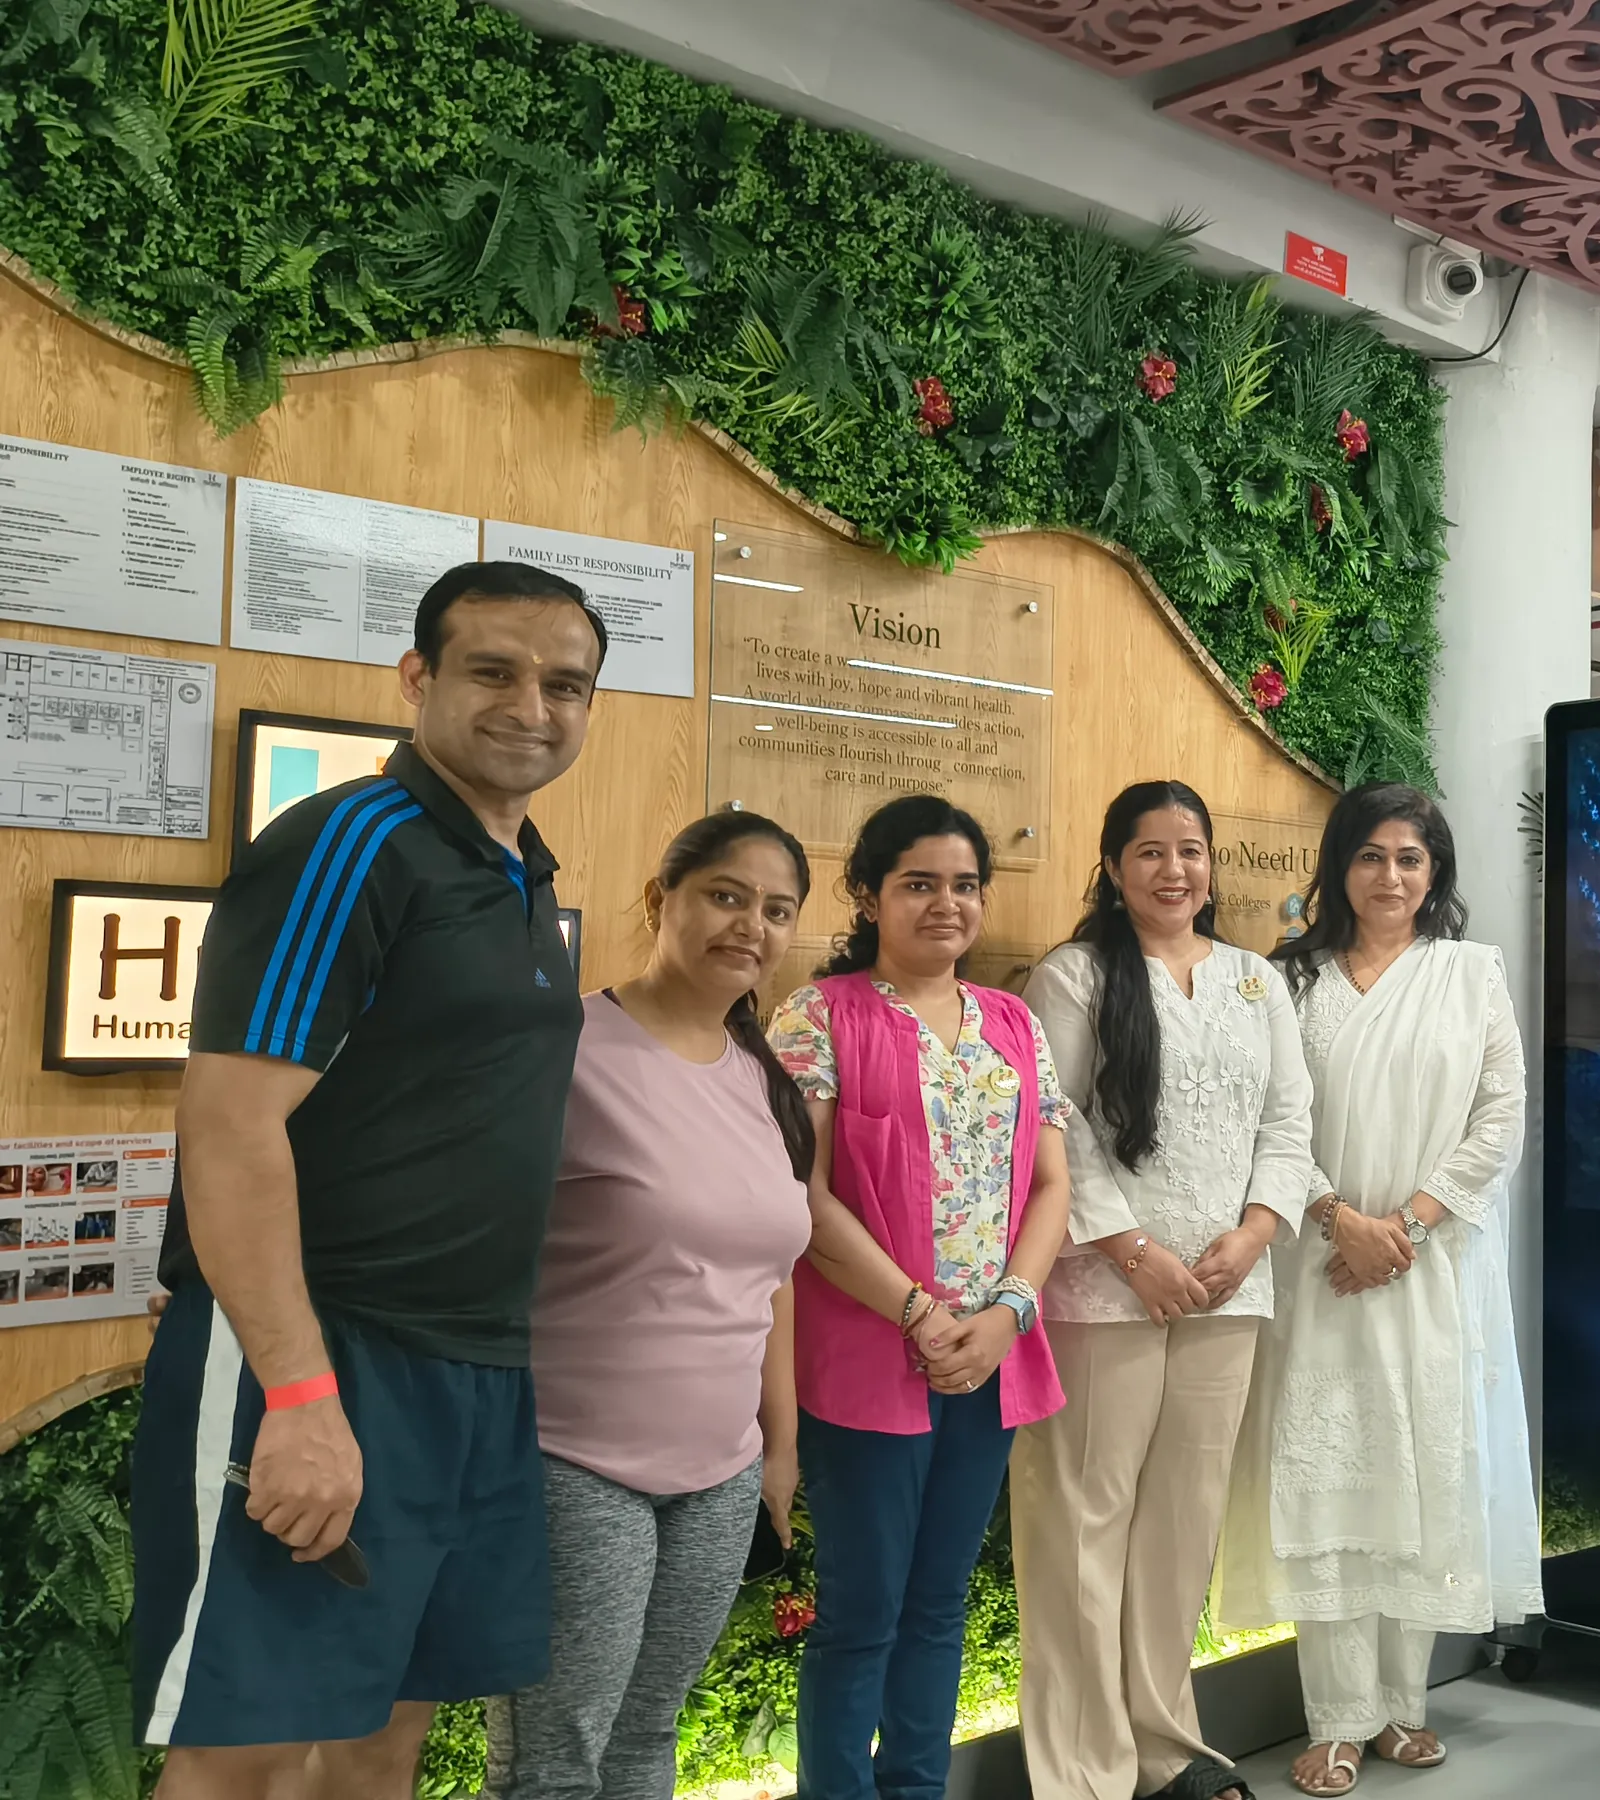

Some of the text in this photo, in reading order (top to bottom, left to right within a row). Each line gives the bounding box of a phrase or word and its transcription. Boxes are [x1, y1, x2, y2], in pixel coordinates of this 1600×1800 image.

[121, 464, 165, 478] EMPLOYEE
[166, 473, 196, 484] RIGHTS
[508, 546, 555, 563] FAMILY
[556, 552, 581, 567] LIST
[583, 557, 673, 580] RESPONSIBILITY
[847, 602, 942, 649] Vision
[774, 645, 820, 663] create
[824, 654, 832, 665] a
[756, 662, 791, 682] lives
[795, 670, 826, 688] with
[829, 673, 854, 693] joy,
[858, 677, 892, 698] hope
[895, 686, 920, 701] and
[924, 689, 969, 709] vibrant
[973, 695, 1015, 716] health.
[743, 684, 755, 699] A
[759, 690, 800, 706] world
[806, 695, 851, 711] where
[984, 719, 1025, 739] action,
[774, 714, 998, 756] well-being is accessible to all and
[738, 735, 835, 757] communities
[839, 743, 892, 765] flourish
[953, 762, 1026, 782] connection,
[825, 767, 856, 783] care
[859, 771, 885, 786] and
[1238, 840, 1295, 873] Need
[1301, 848, 1319, 875] U
[1228, 893, 1271, 911] Colleges
[92, 1014, 193, 1040] Huma
[14, 1140, 53, 1150] facilities
[55, 1139, 73, 1149] and
[76, 1138, 102, 1149] scope
[105, 1138, 115, 1146] of
[117, 1136, 152, 1146] services
